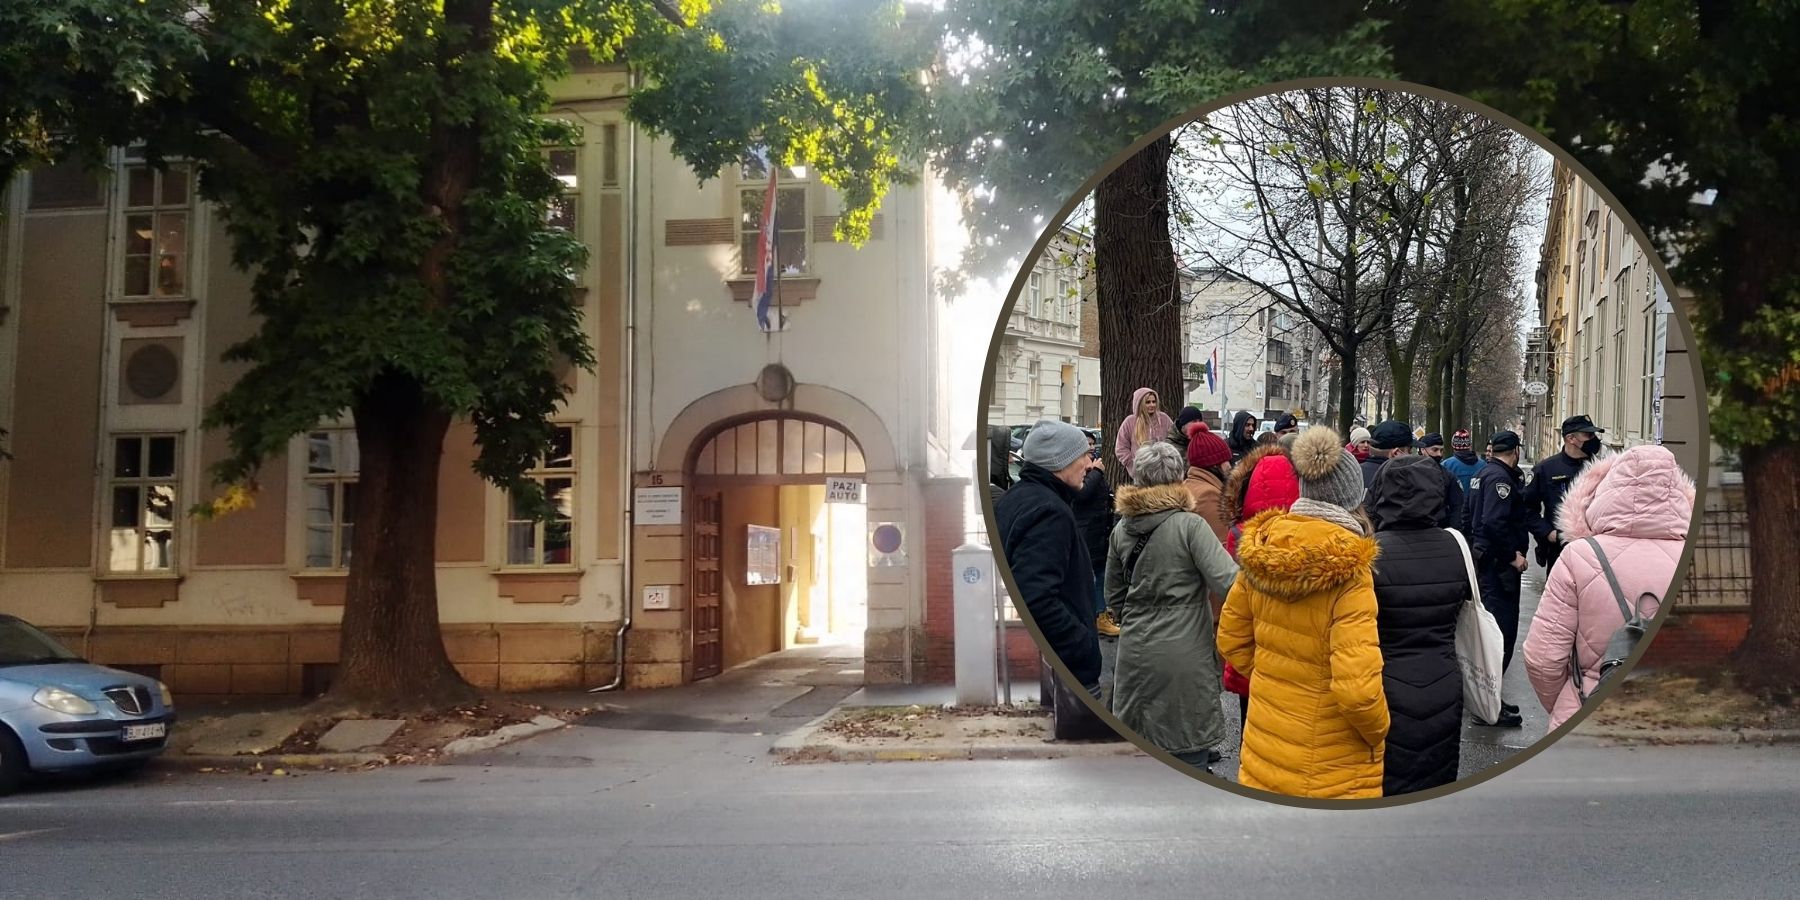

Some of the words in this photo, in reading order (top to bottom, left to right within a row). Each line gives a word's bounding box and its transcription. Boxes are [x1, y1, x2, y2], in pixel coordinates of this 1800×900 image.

[652, 474, 664, 485] 15
[833, 481, 857, 491] PAZI
[829, 491, 859, 501] AUTO
